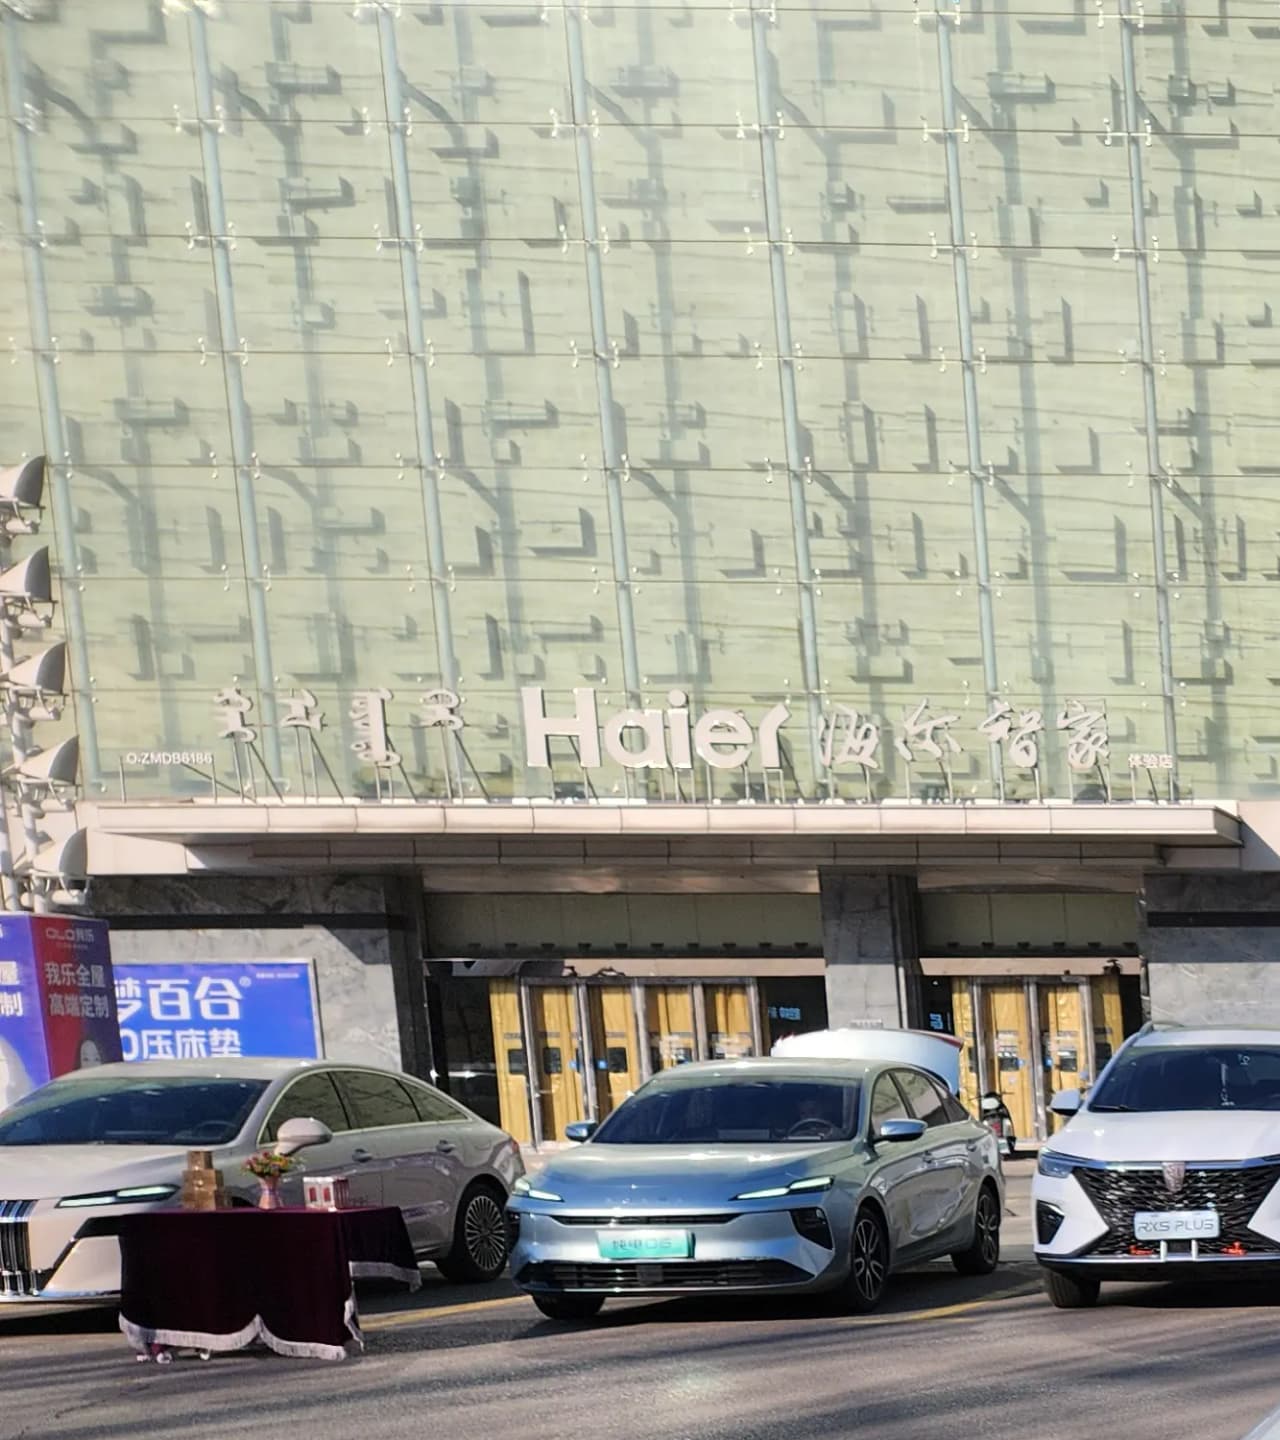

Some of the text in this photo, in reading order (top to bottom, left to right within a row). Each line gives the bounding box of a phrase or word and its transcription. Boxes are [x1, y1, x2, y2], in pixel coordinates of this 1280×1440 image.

[521, 686, 791, 768] Haier
[819, 697, 1111, 769] 海尔智家
[1128, 753, 1173, 768] 体验店
[44, 962, 106, 988] 我乐全屋
[49, 994, 110, 1018] 高端定制
[1175, 1219, 1214, 1231] PLUS
